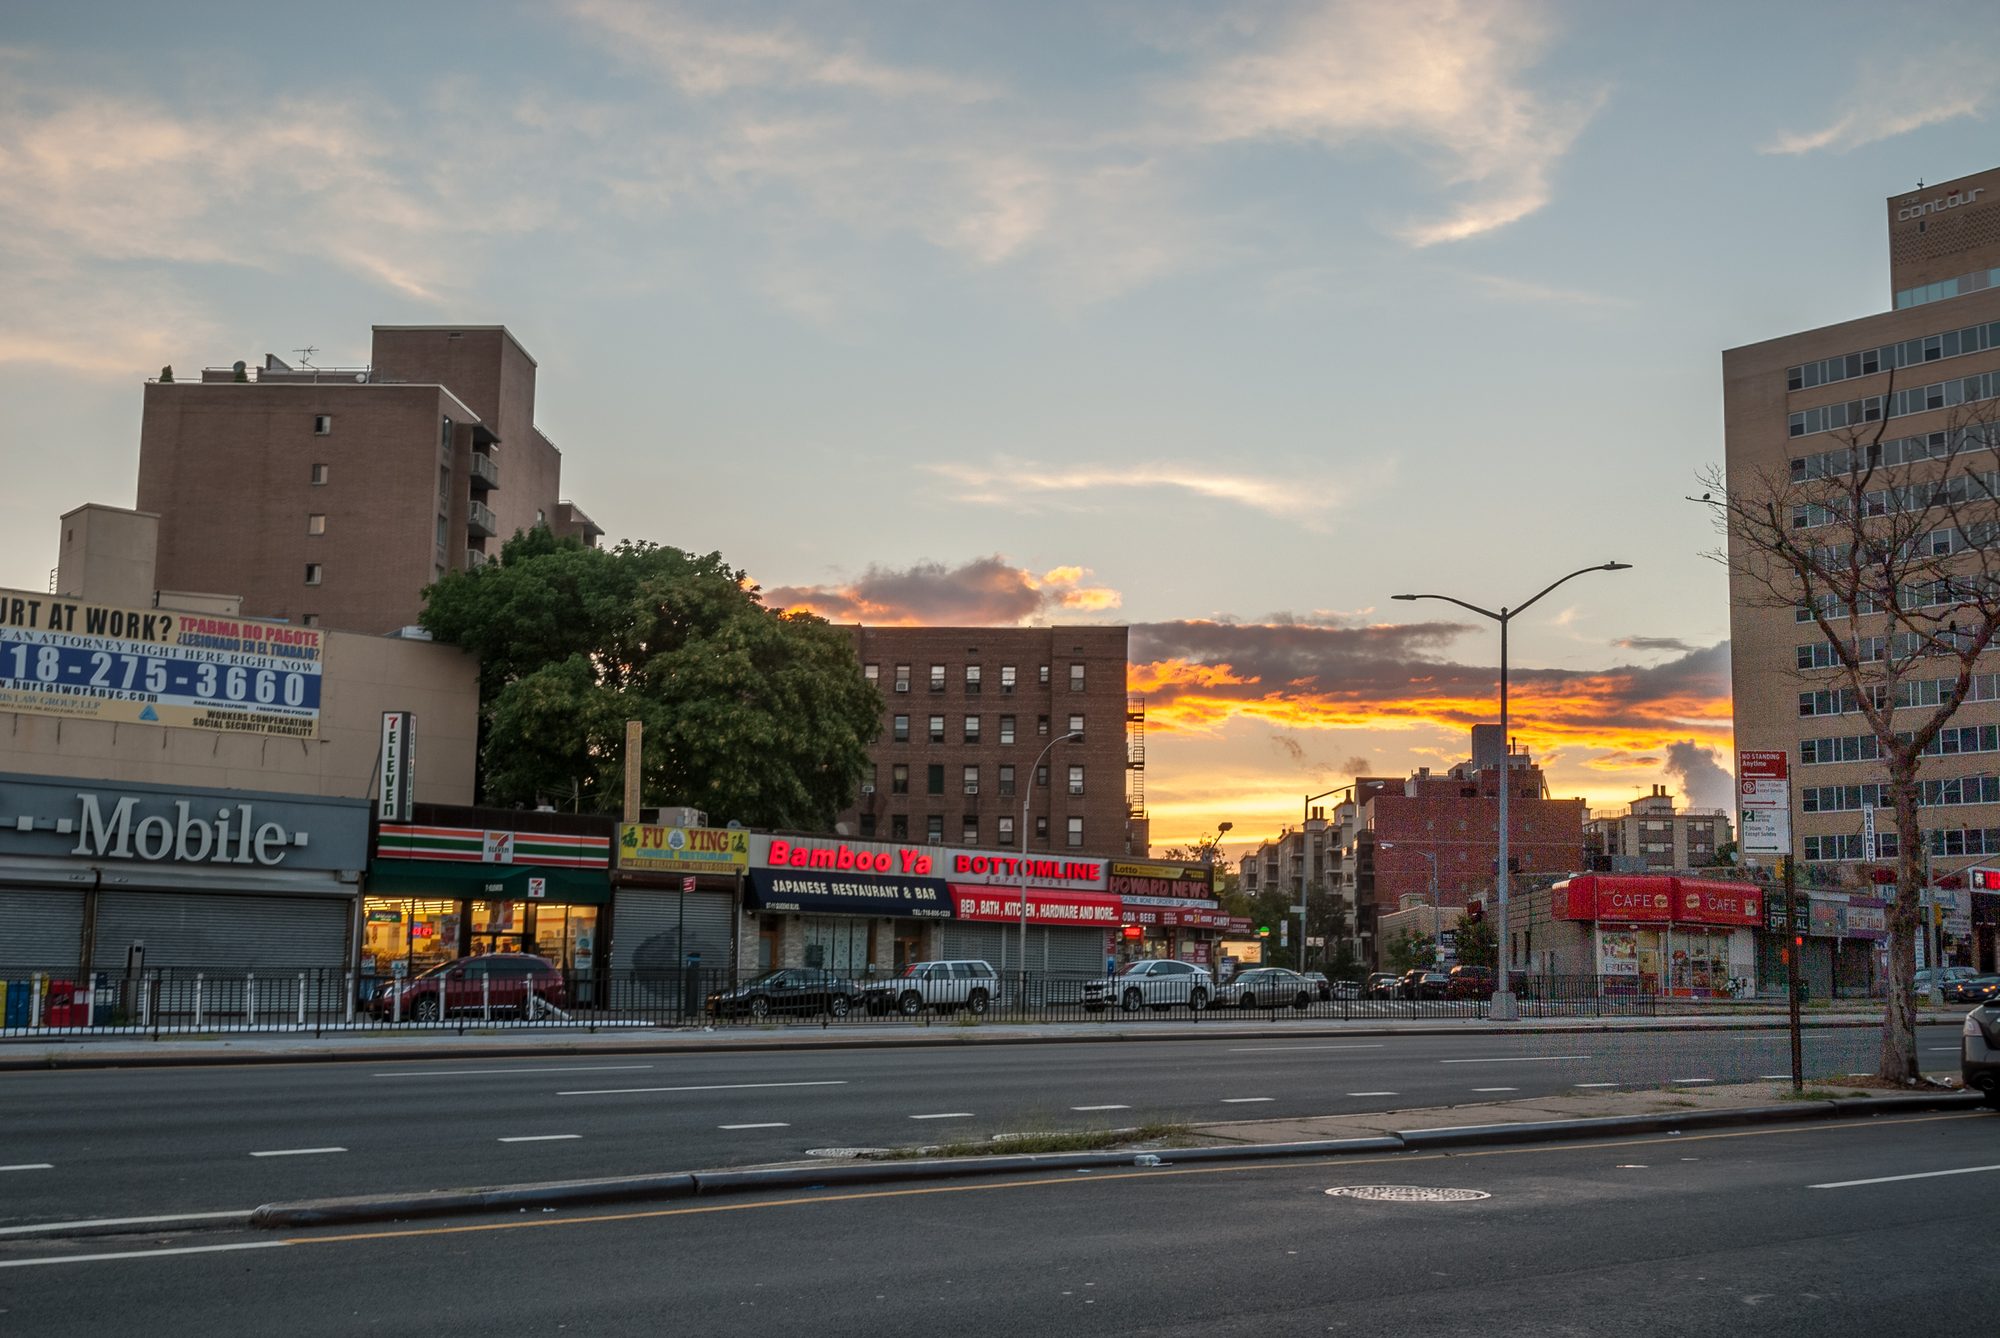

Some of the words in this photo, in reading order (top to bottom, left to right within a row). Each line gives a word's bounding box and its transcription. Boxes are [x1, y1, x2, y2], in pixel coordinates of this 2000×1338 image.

[48, 603, 77, 632] AT
[86, 607, 172, 641] WORK?
[179, 616, 239, 637] ТРАВМА
[242, 624, 262, 640] ПО
[266, 627, 319, 647] РАБОТЕ
[12, 631, 34, 641] AN
[39, 633, 125, 652] ATTORNEY
[131, 643, 179, 658] RIGHT
[185, 649, 225, 663] HERE
[230, 655, 275, 669] RIGHT
[281, 660, 314, 672] NOW
[242, 640, 255, 653] EN
[257, 642, 268, 655] EL
[270, 643, 320, 661] TRABAJO?
[0, 643, 305, 706] 18-275-3660
[193, 718, 223, 729] SOCIAL
[225, 720, 266, 732] SECURITY
[268, 725, 313, 736] DISABILITY
[207, 710, 249, 722] WORKERS
[251, 714, 313, 728] COMPENSATION
[388, 716, 398, 729] 7
[1744, 810, 1753, 821] 2
[71, 793, 287, 865] Mobile
[641, 826, 664, 848] FU
[688, 830, 729, 852] YING
[1866, 812, 1875, 863] PHARMACY
[489, 832, 509, 861] 7
[768, 840, 893, 872] Bamboo
[899, 848, 933, 875] Ya
[955, 854, 1101, 881] BOTTOMLINE
[1114, 864, 1138, 874] Lotto
[772, 879, 829, 895] JAPANESE
[832, 883, 899, 898] RESTAURANT
[903, 887, 912, 899] &
[915, 887, 937, 900] BAR
[986, 875, 1019, 884] SUPE
[1030, 878, 1071, 887] STORE
[1108, 876, 1169, 897] HOWARD
[1172, 880, 1209, 898] NEWS
[1004, 901, 1036, 917] KITCEN
[1040, 903, 1078, 919] HARDWARE
[1079, 905, 1093, 920] AND
[1612, 894, 1652, 907] CAFE
[1708, 897, 1737, 912] CAFE
[1140, 913, 1157, 923] BEER
[1212, 916, 1231, 926] CANDY
[1770, 916, 1807, 929] OPTAL
